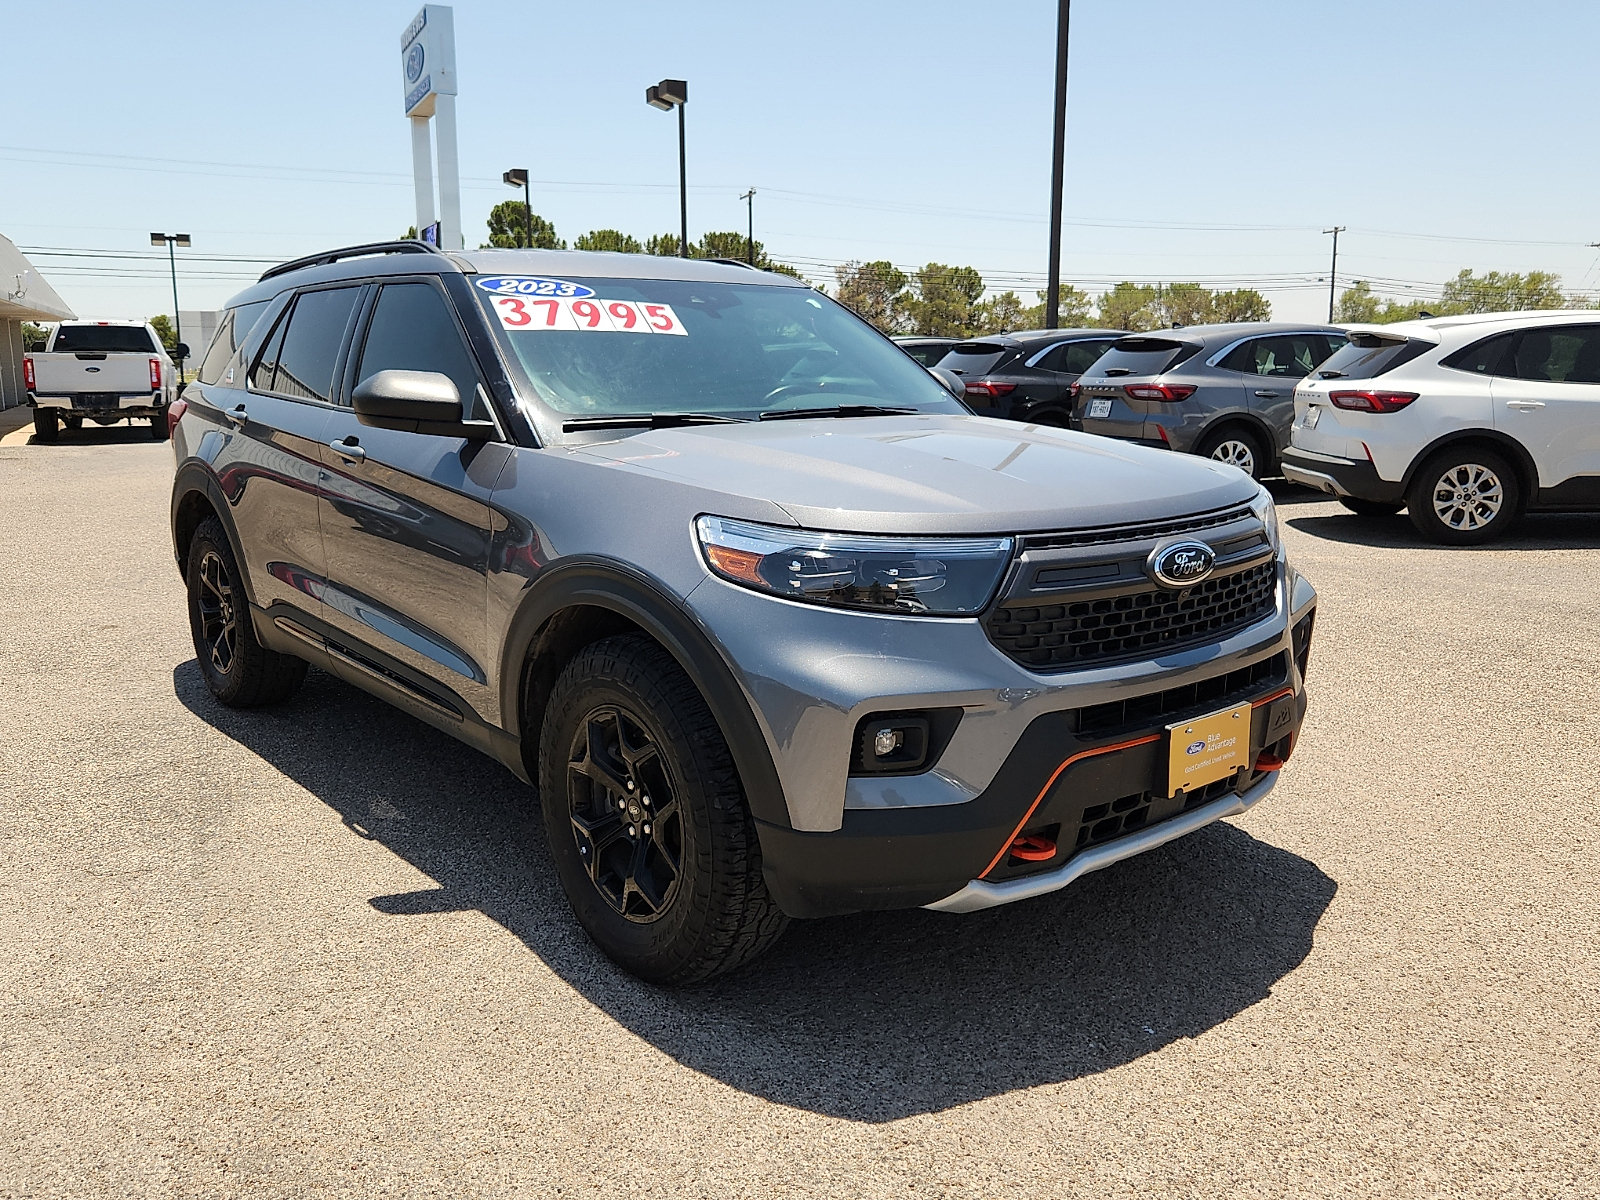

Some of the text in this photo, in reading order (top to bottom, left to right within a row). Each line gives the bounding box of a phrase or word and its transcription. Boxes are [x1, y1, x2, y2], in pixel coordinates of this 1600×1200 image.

[499, 279, 577, 297] 2023
[498, 298, 674, 331] 37995
[1173, 551, 1205, 576] Ford
[1207, 733, 1221, 743] Blue
[1207, 737, 1236, 753] Advantage
